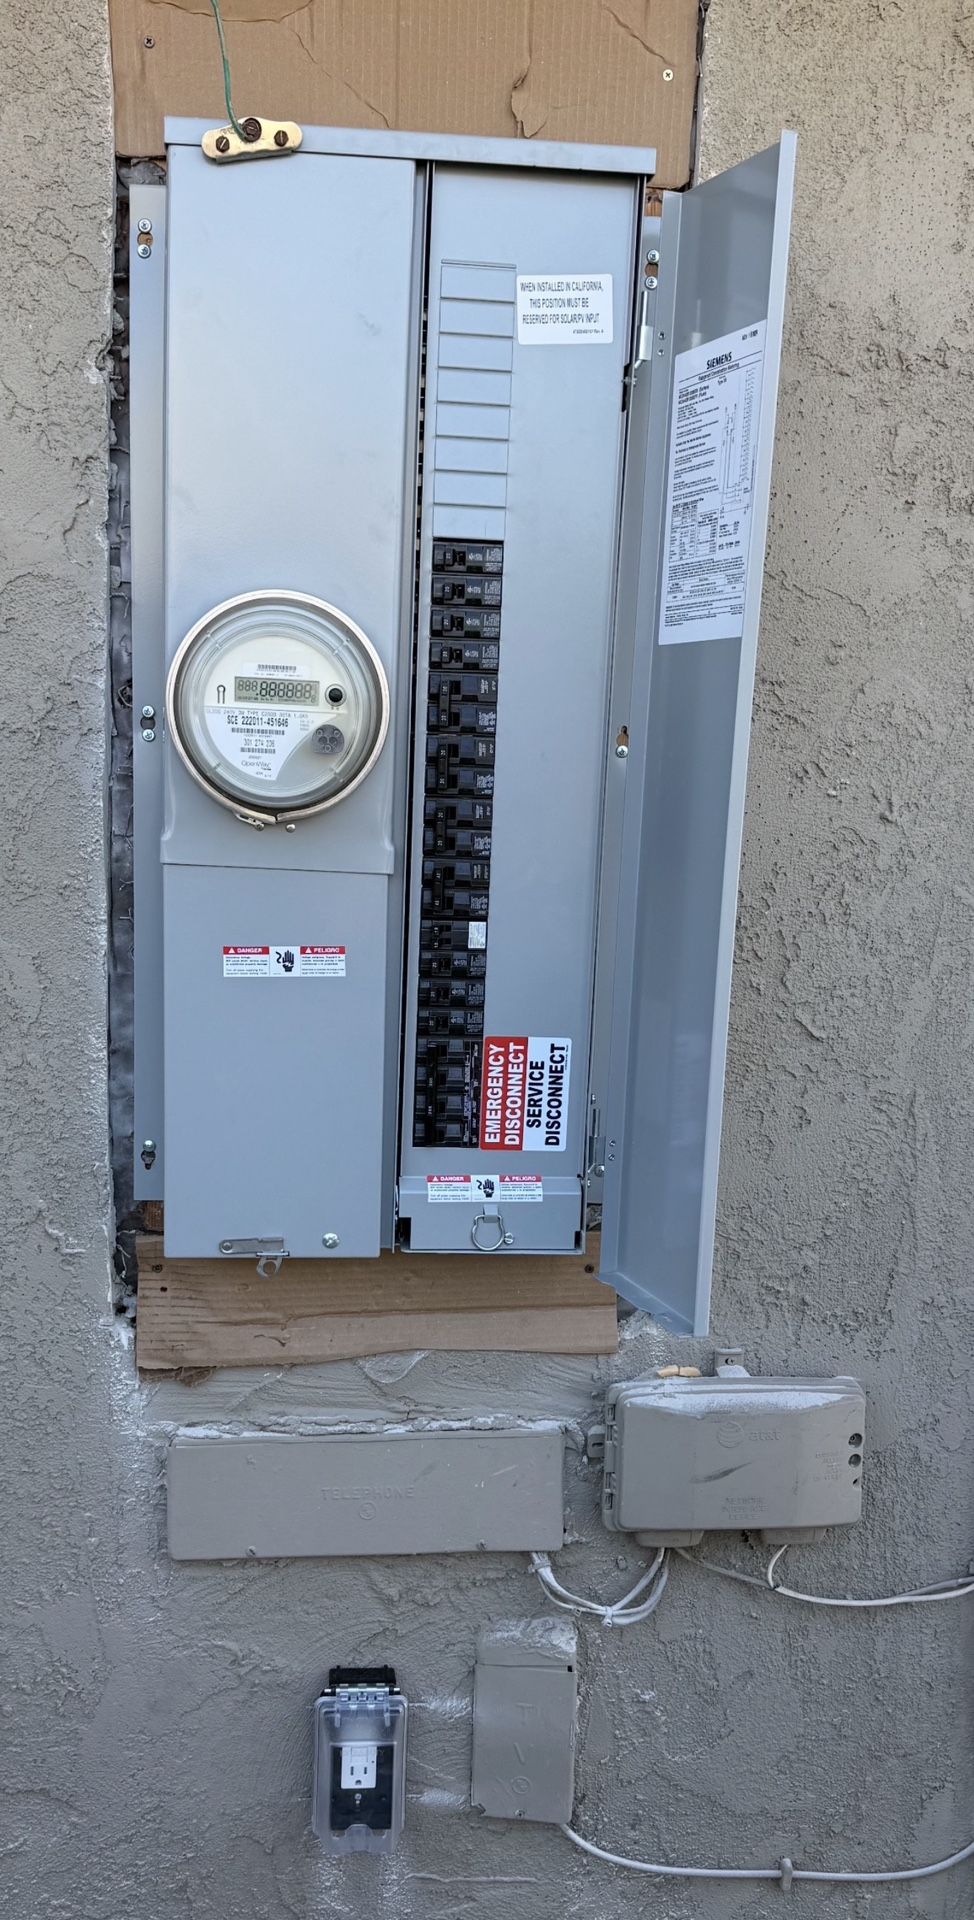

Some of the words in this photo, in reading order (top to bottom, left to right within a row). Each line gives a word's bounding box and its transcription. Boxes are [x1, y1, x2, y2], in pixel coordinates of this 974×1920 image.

[520, 282, 536, 292] WHEN
[537, 282, 564, 292] INSTALLED
[565, 281, 571, 291] IN
[530, 298, 541, 308] THIS
[542, 298, 566, 308] POSITION
[566, 298, 581, 308] MUST
[582, 297, 589, 308] BE
[522, 314, 549, 324] RESERVED
[549, 314, 560, 324] FOR
[585, 313, 600, 323] INPUT
[706, 351, 732, 370] SIEMENS
[227, 715, 238, 725] SCE
[485, 1043, 505, 1144] EMERGENCY
[504, 1042, 525, 1145] DISCONNECT
[526, 1060, 545, 1129] SERVICE
[544, 1043, 566, 1146] DISCONNECT
[320, 1486, 415, 1501] TELEPHONE
